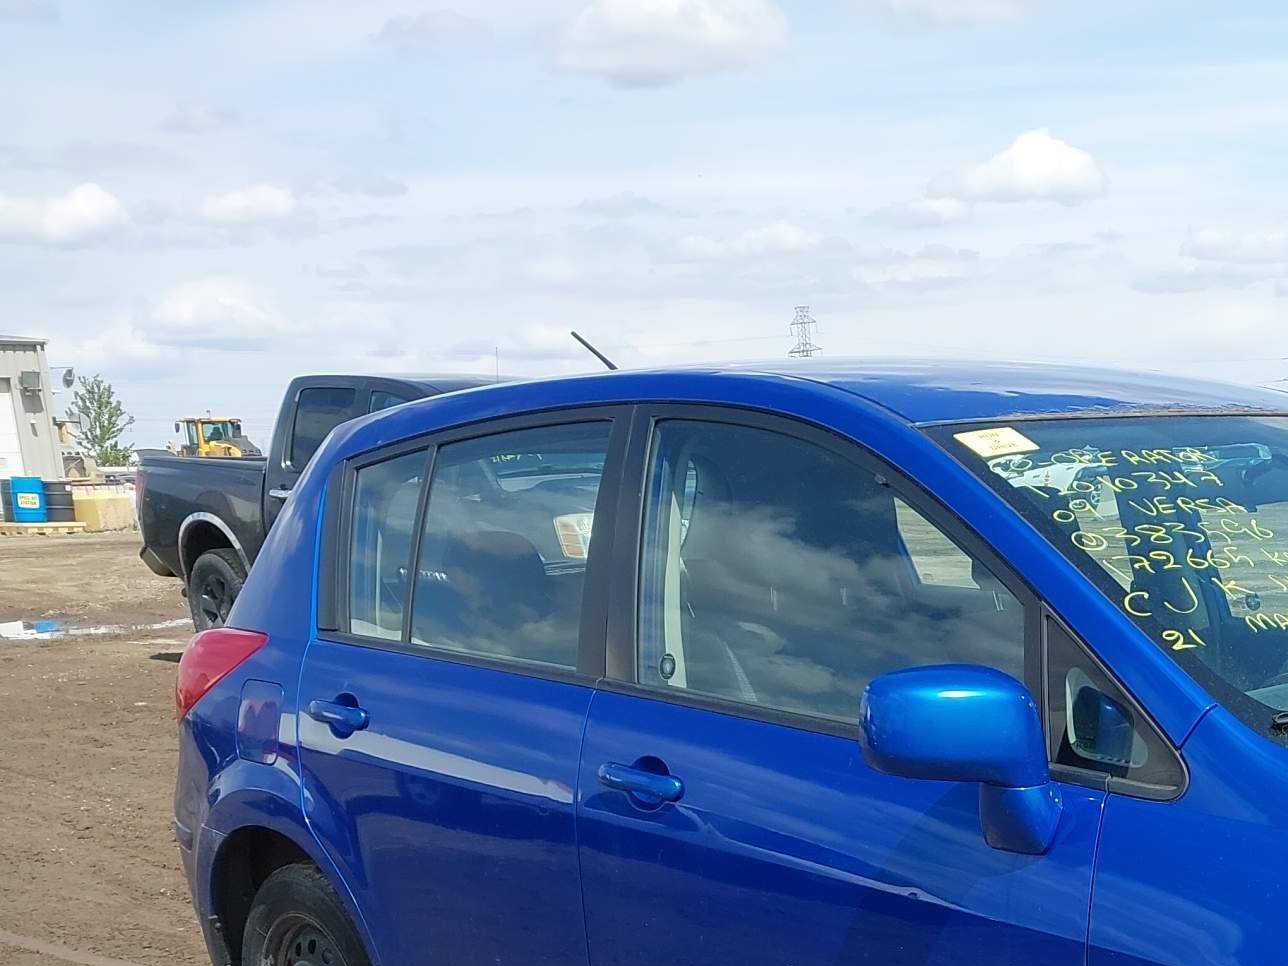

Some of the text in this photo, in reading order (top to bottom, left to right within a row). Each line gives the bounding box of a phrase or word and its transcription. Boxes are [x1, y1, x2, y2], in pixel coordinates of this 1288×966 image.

[1021, 471, 1224, 498] 12010347
[1128, 496, 1248, 517] VERSA
[1162, 628, 1208, 651] 21
